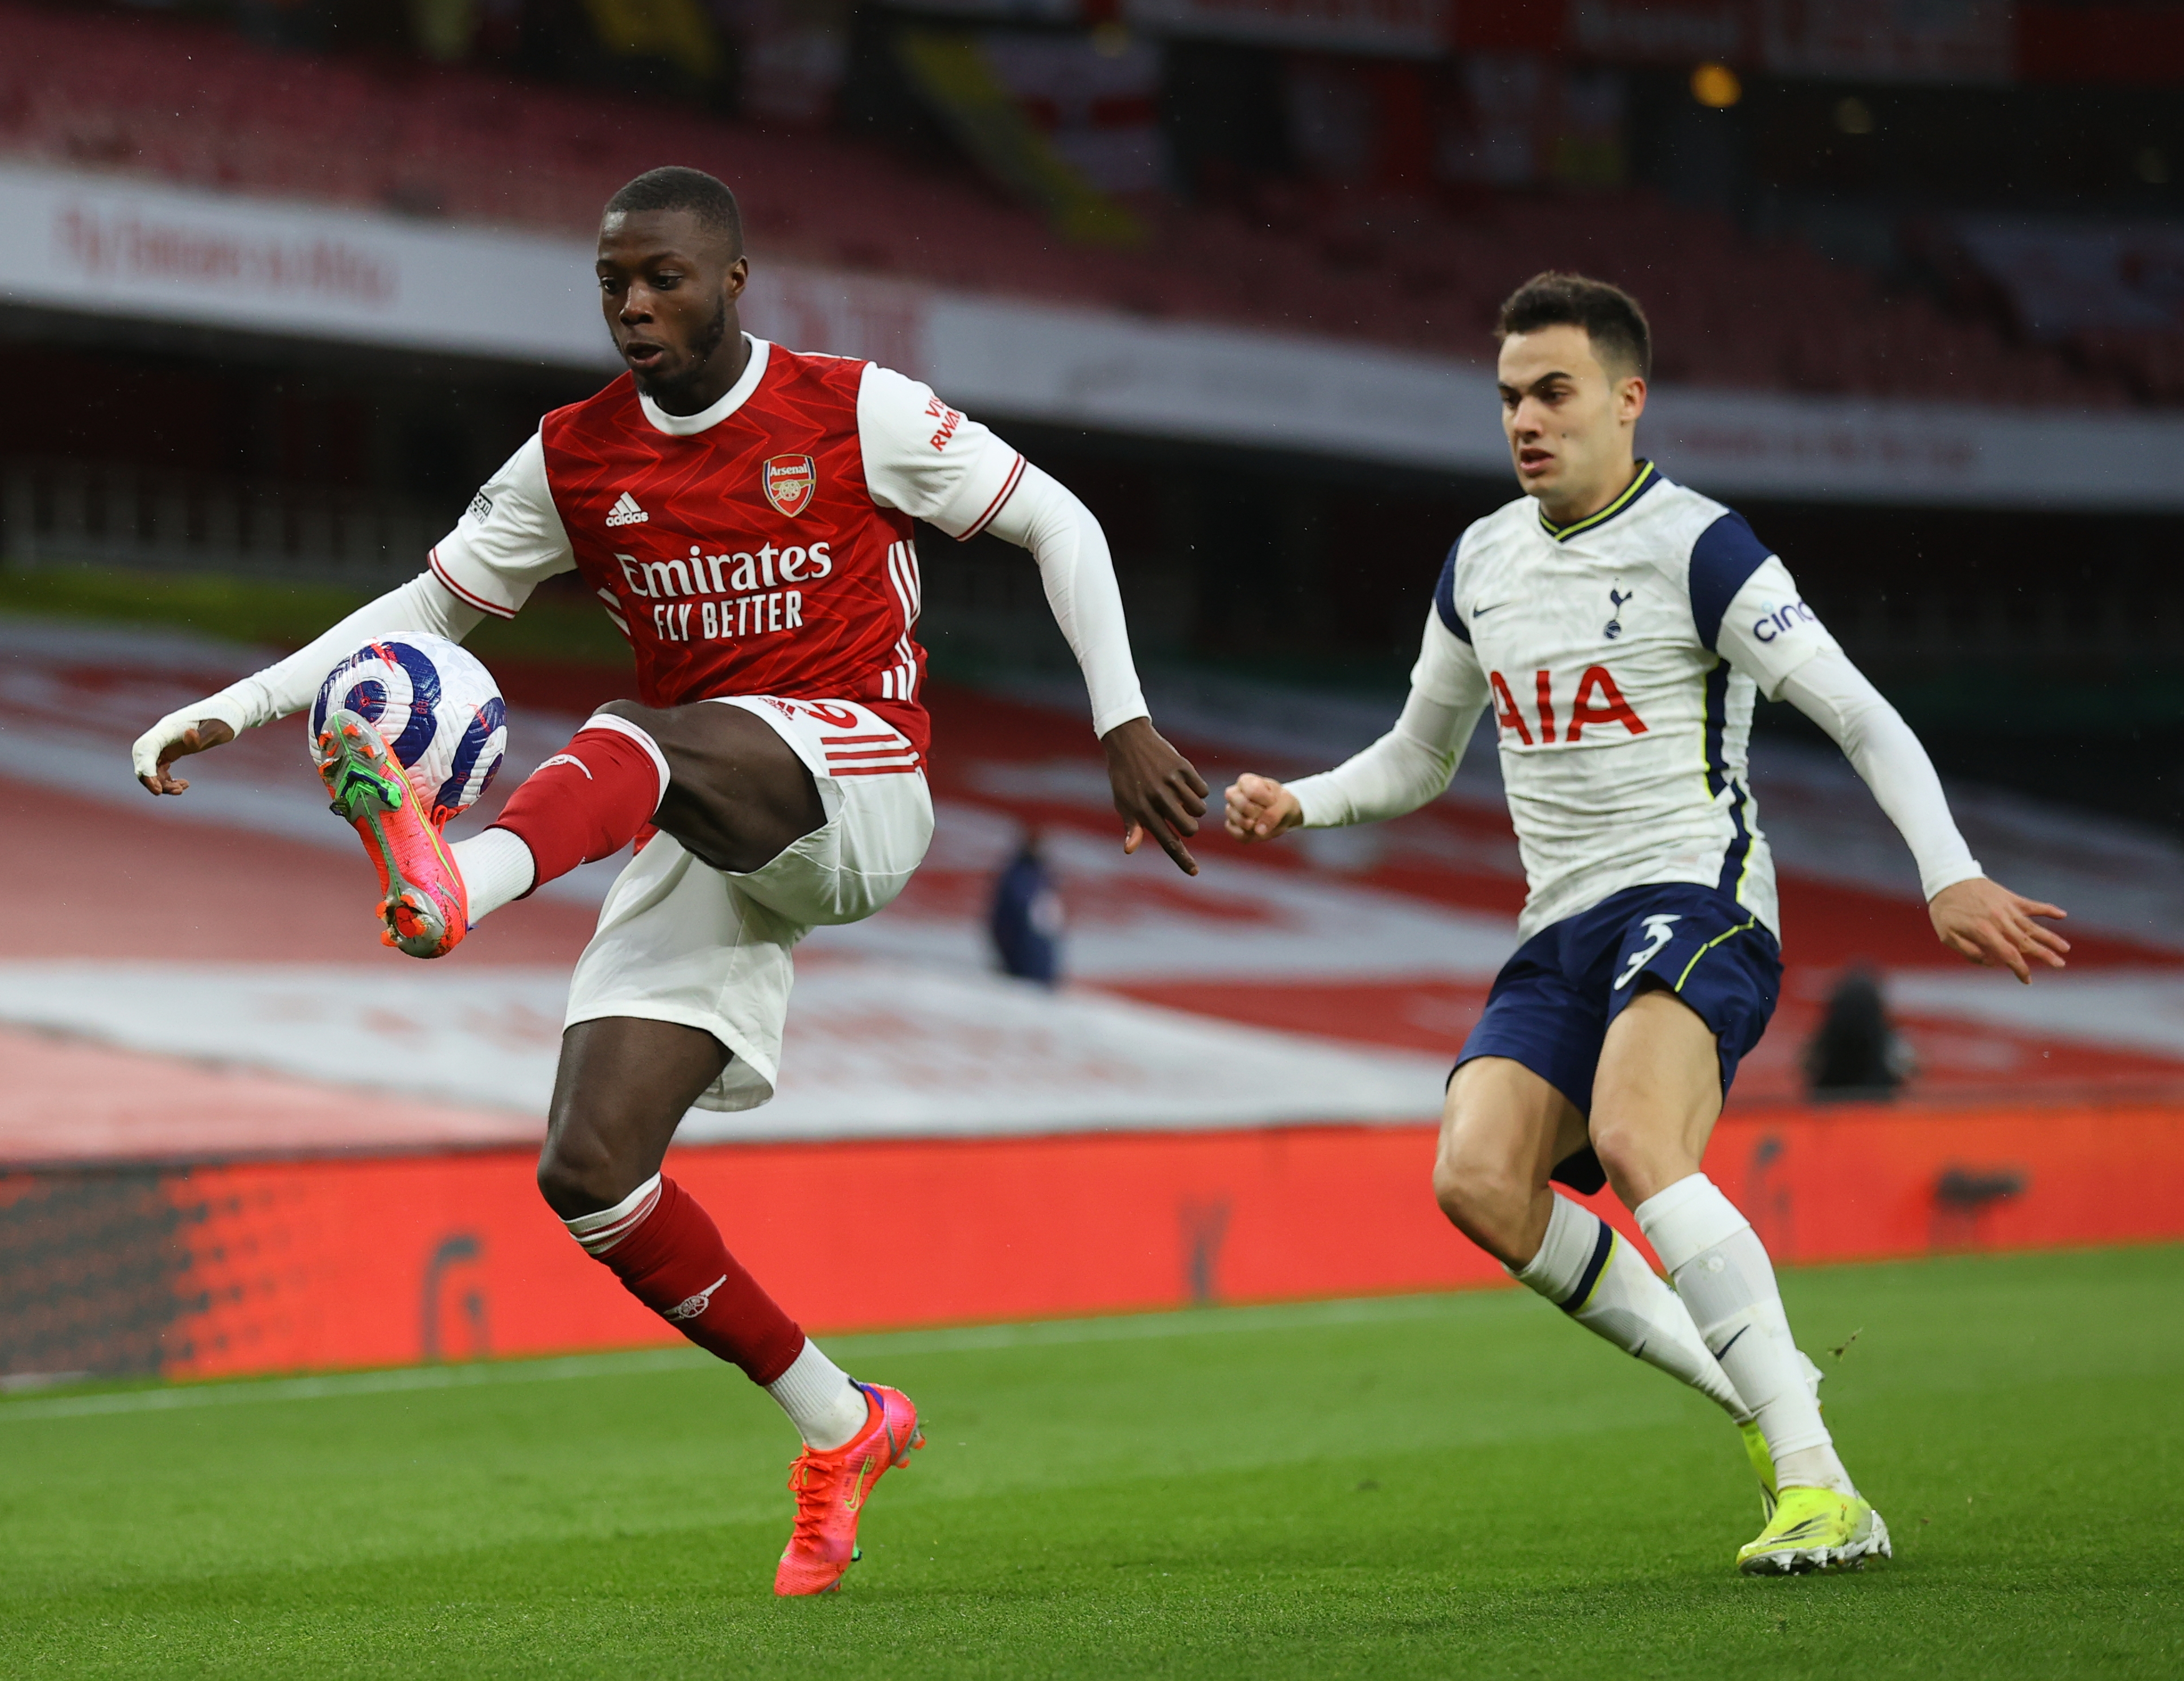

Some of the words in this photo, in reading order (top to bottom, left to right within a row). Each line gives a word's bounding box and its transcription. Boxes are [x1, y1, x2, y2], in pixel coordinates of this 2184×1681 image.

[930, 410, 960, 452] RWA
[769, 463, 811, 477] Arsenal
[605, 512, 649, 527] adidas
[613, 541, 832, 597] Emirates
[653, 603, 693, 641] FLY
[701, 590, 803, 640] BETTER
[1490, 665, 1649, 746] AIA
[1614, 914, 1682, 991] 3
